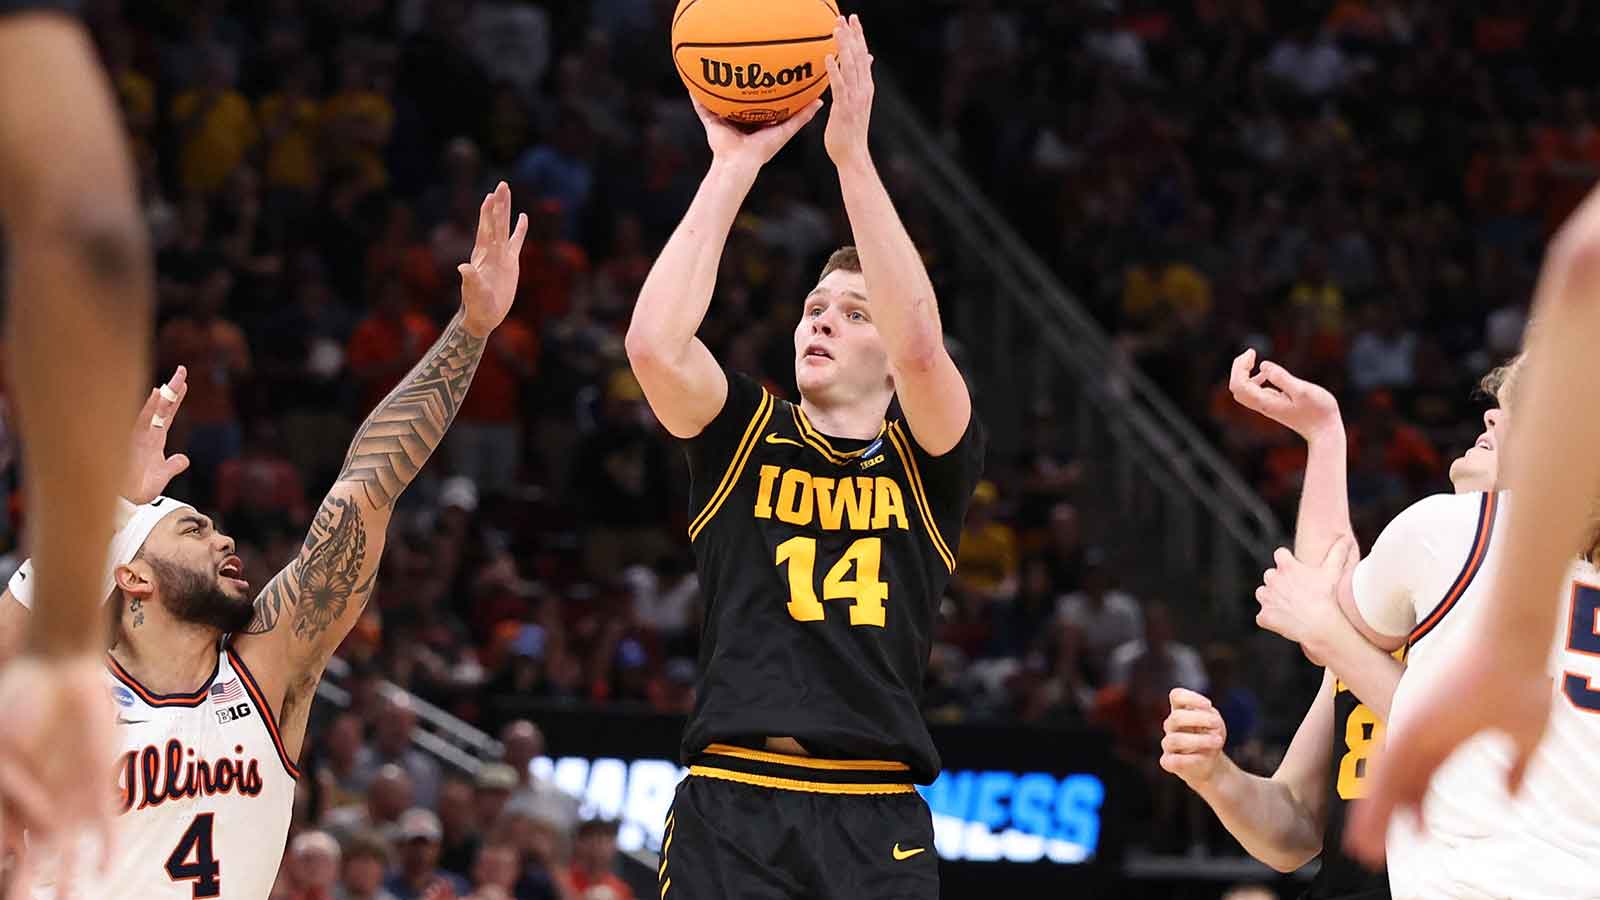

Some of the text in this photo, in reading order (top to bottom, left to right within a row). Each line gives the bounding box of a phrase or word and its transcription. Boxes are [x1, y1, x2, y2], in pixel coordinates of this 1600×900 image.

[700, 57, 814, 89] Wilson
[754, 464, 909, 530] IOWA
[775, 536, 889, 628] 14
[115, 738, 263, 816] Illinois
[918, 768, 1105, 864] NESS
[163, 812, 221, 900] 4
